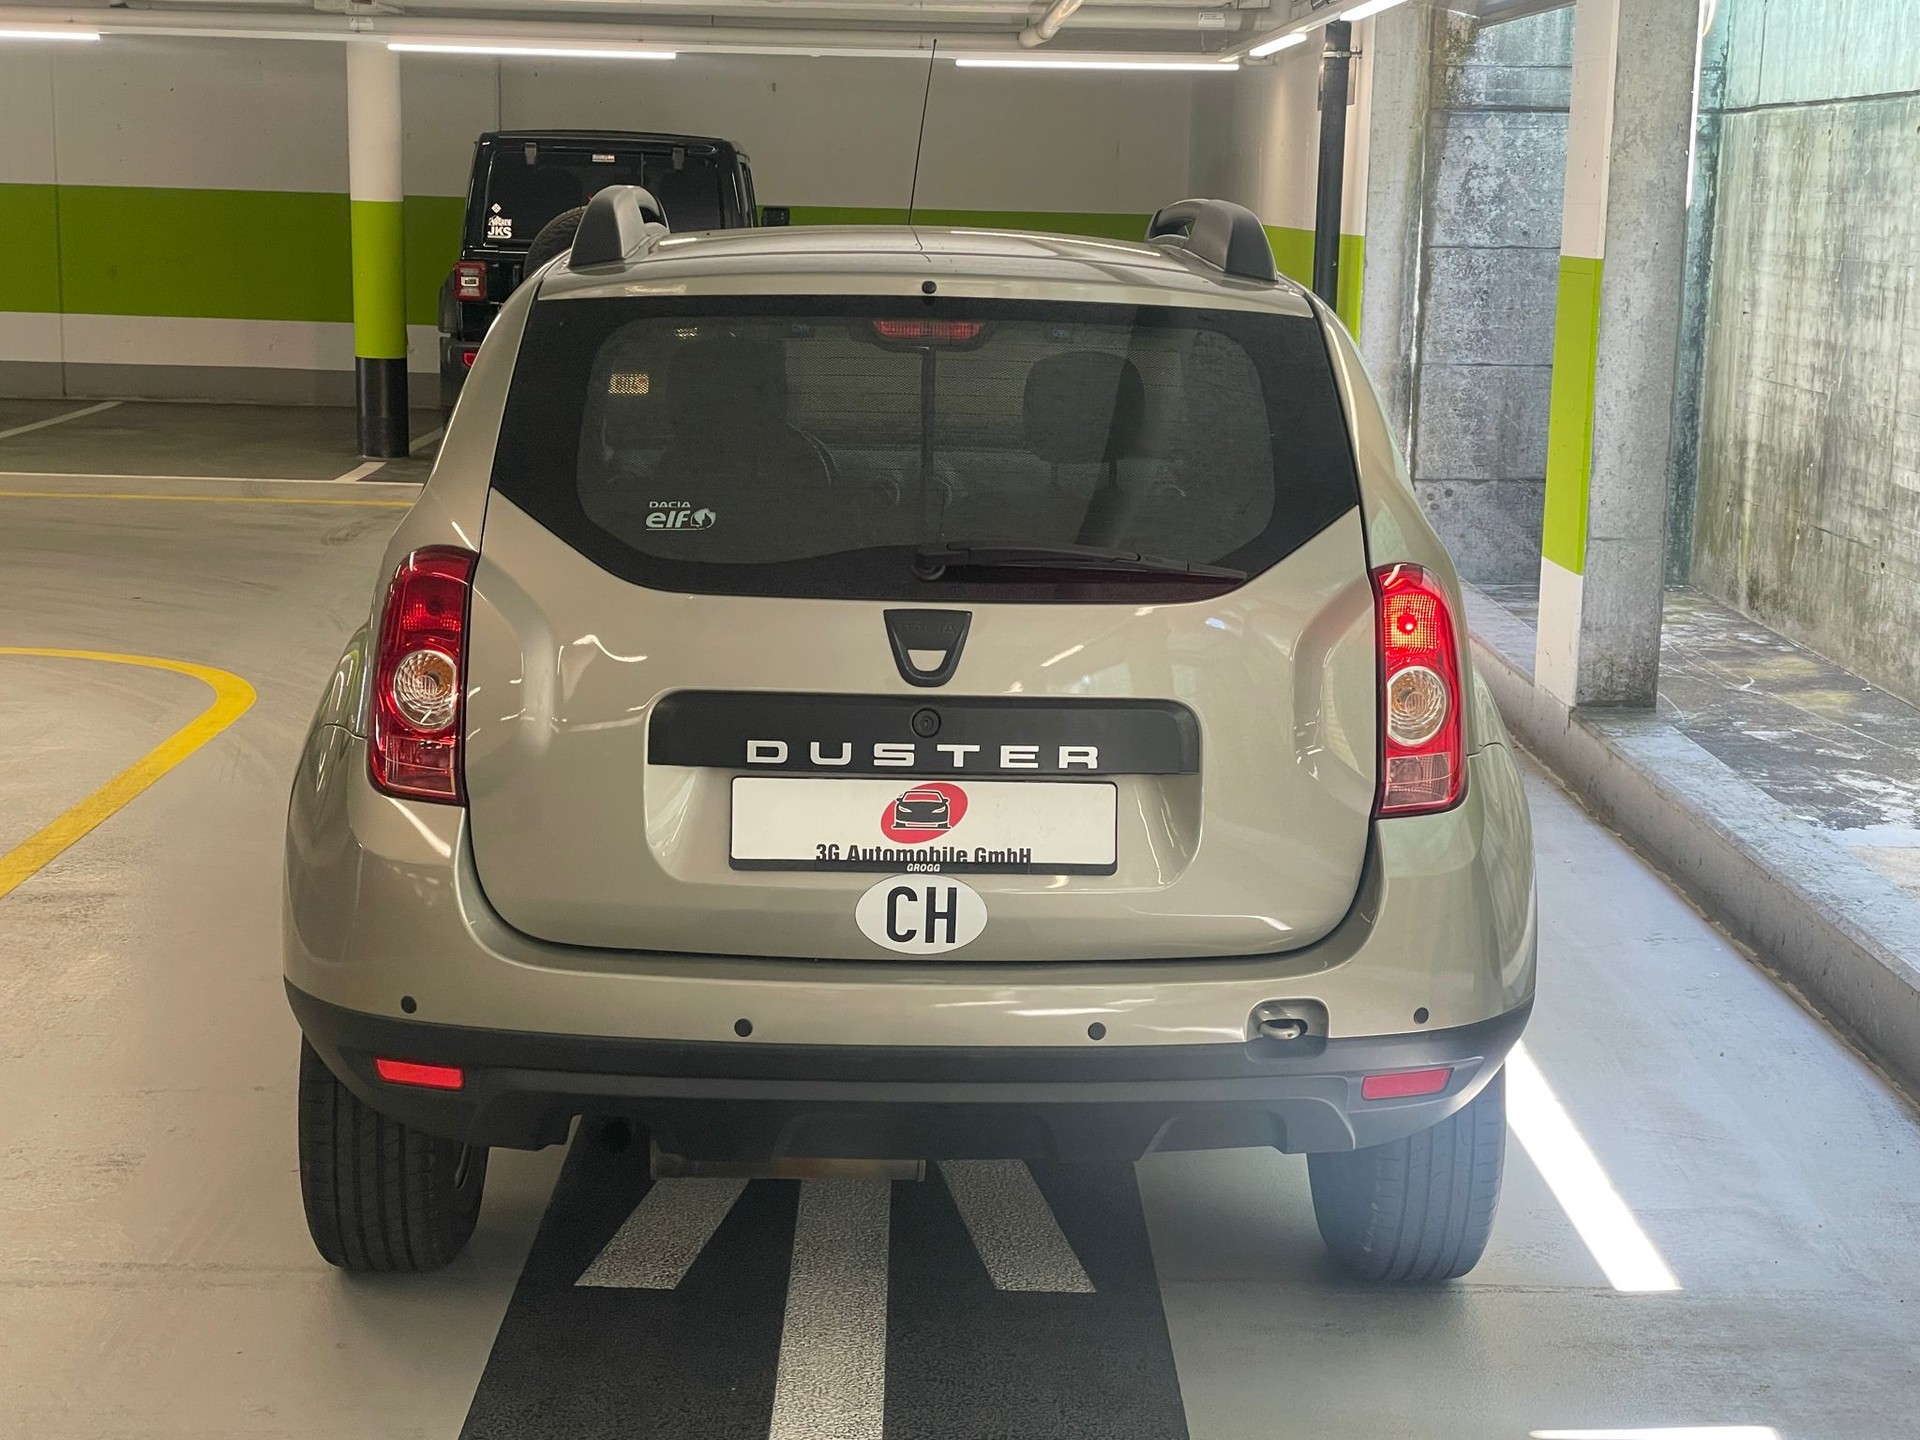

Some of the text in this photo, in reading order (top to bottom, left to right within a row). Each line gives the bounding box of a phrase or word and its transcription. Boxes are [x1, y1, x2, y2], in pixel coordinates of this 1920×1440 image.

[487, 226, 512, 239] JKS
[645, 510, 691, 528] elf
[746, 740, 1099, 770] DUSTER
[816, 843, 1031, 864] 3G Automobile GmbH
[906, 863, 941, 873] GROGG
[886, 886, 957, 944] CH
